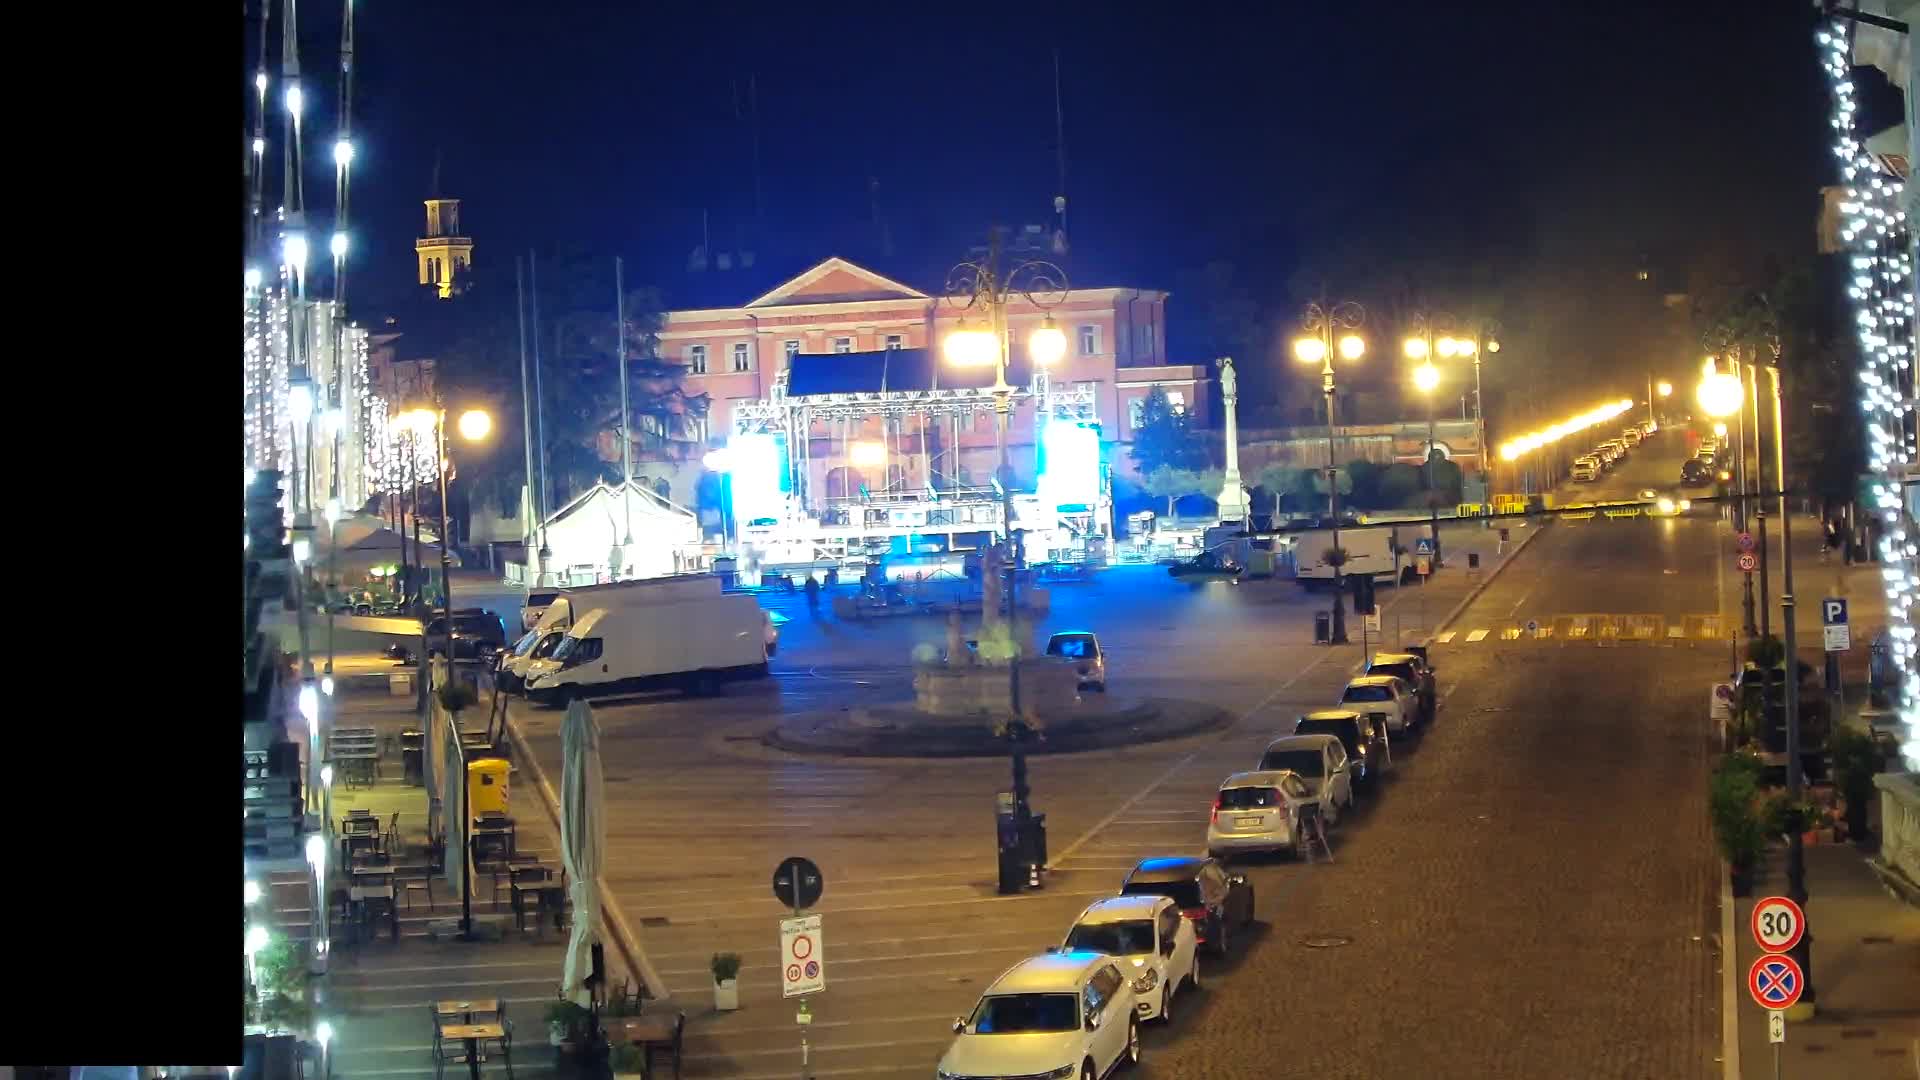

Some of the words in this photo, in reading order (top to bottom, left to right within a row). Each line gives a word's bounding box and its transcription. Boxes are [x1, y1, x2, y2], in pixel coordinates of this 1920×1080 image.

[1742, 558, 1752, 567] 20
[1827, 602, 1842, 622] P
[1762, 912, 1791, 937] 30
